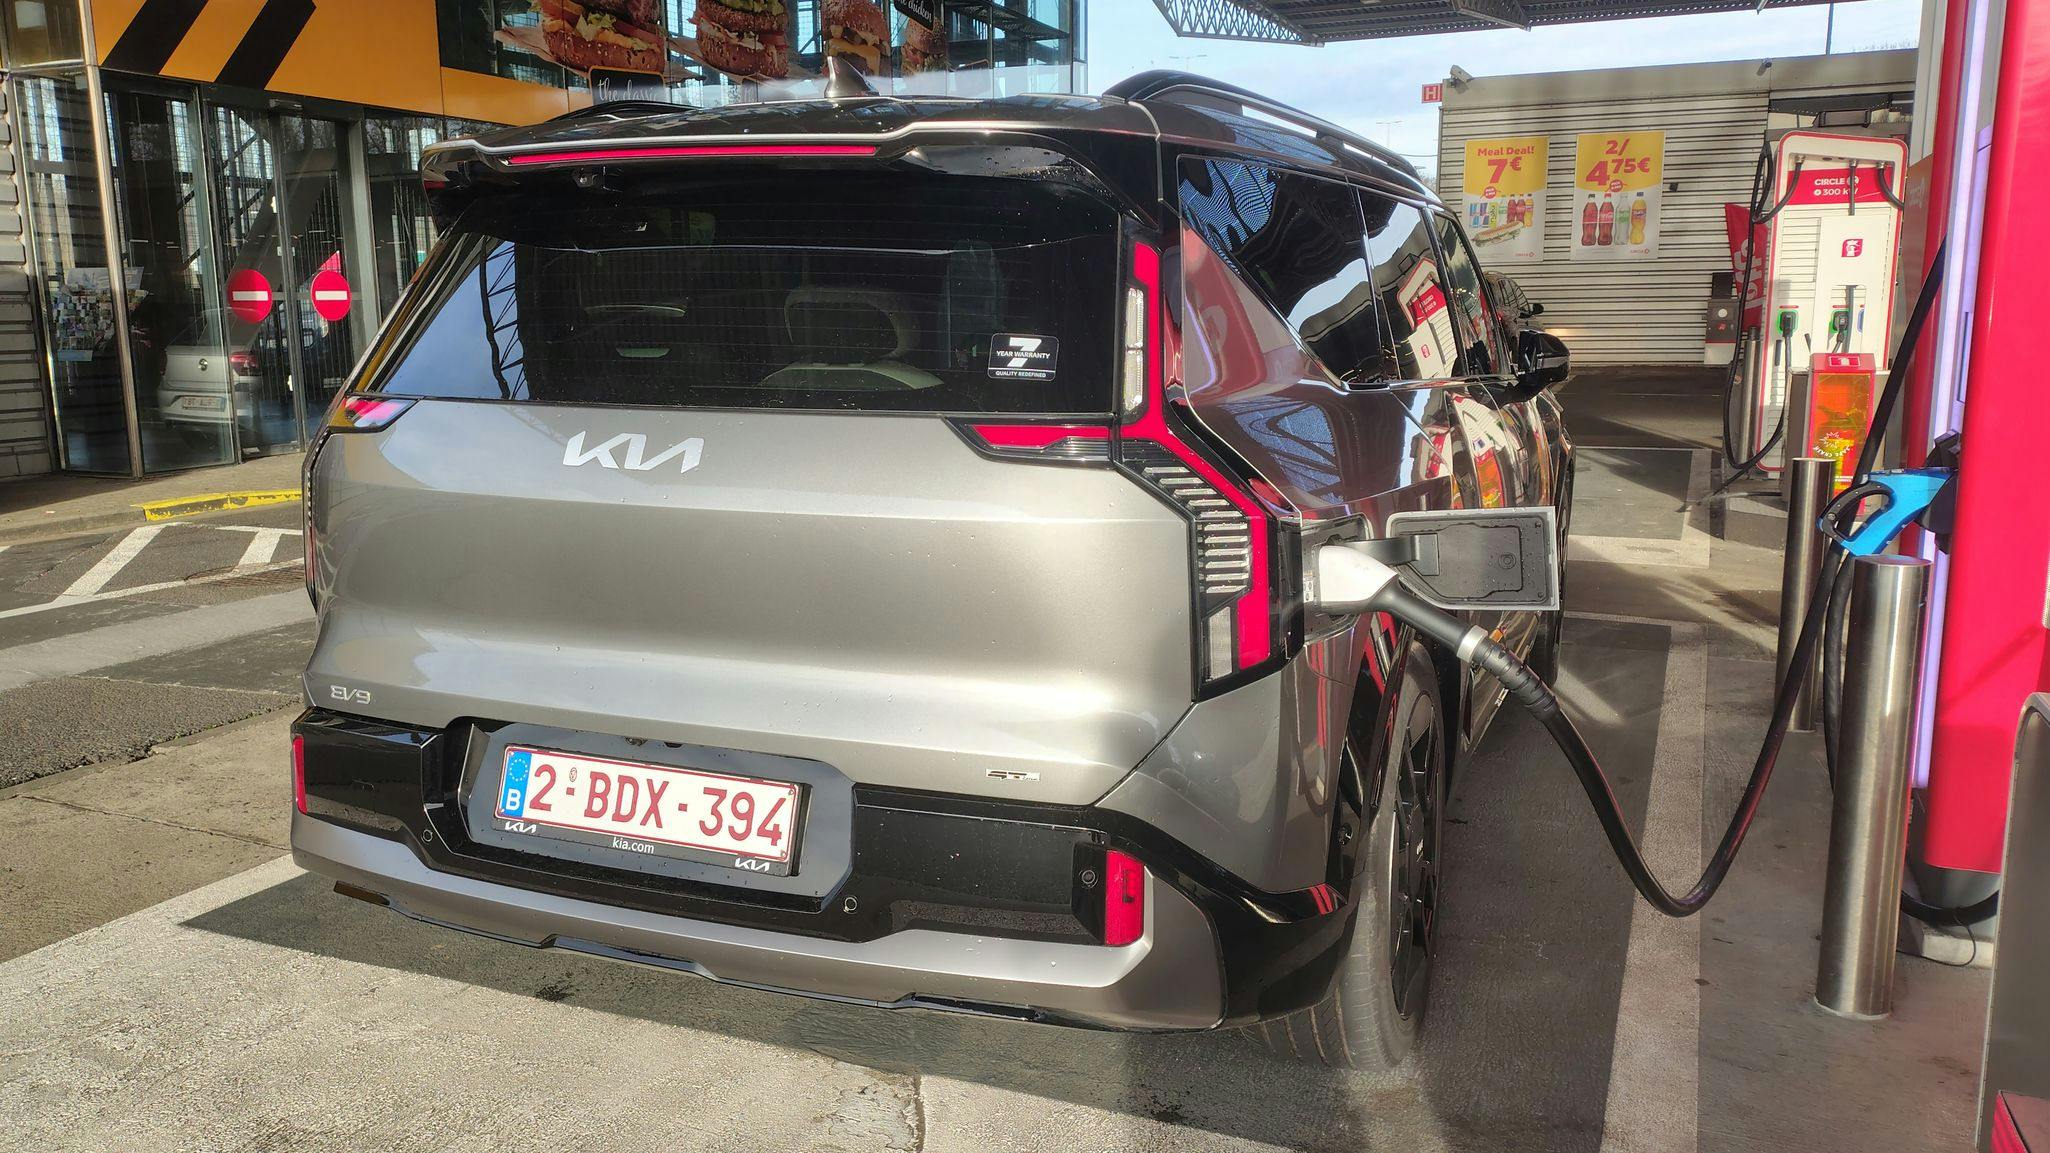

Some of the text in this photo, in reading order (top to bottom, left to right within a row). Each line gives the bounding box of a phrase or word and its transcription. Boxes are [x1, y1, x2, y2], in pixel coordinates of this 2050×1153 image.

[597, 77, 619, 102] the
[1477, 146, 1535, 156] Meal Deal!
[1605, 138, 1630, 156] 2/
[1487, 156, 1522, 184] 7€
[1814, 177, 1845, 185] CIRCLE
[996, 350, 1051, 359] YEAR WARRANTY
[562, 430, 705, 474] KIA
[329, 684, 371, 705] EV9
[505, 788, 522, 811] B
[505, 820, 537, 833] KIA
[612, 837, 655, 854] kia.com
[735, 857, 770, 872] KIA
